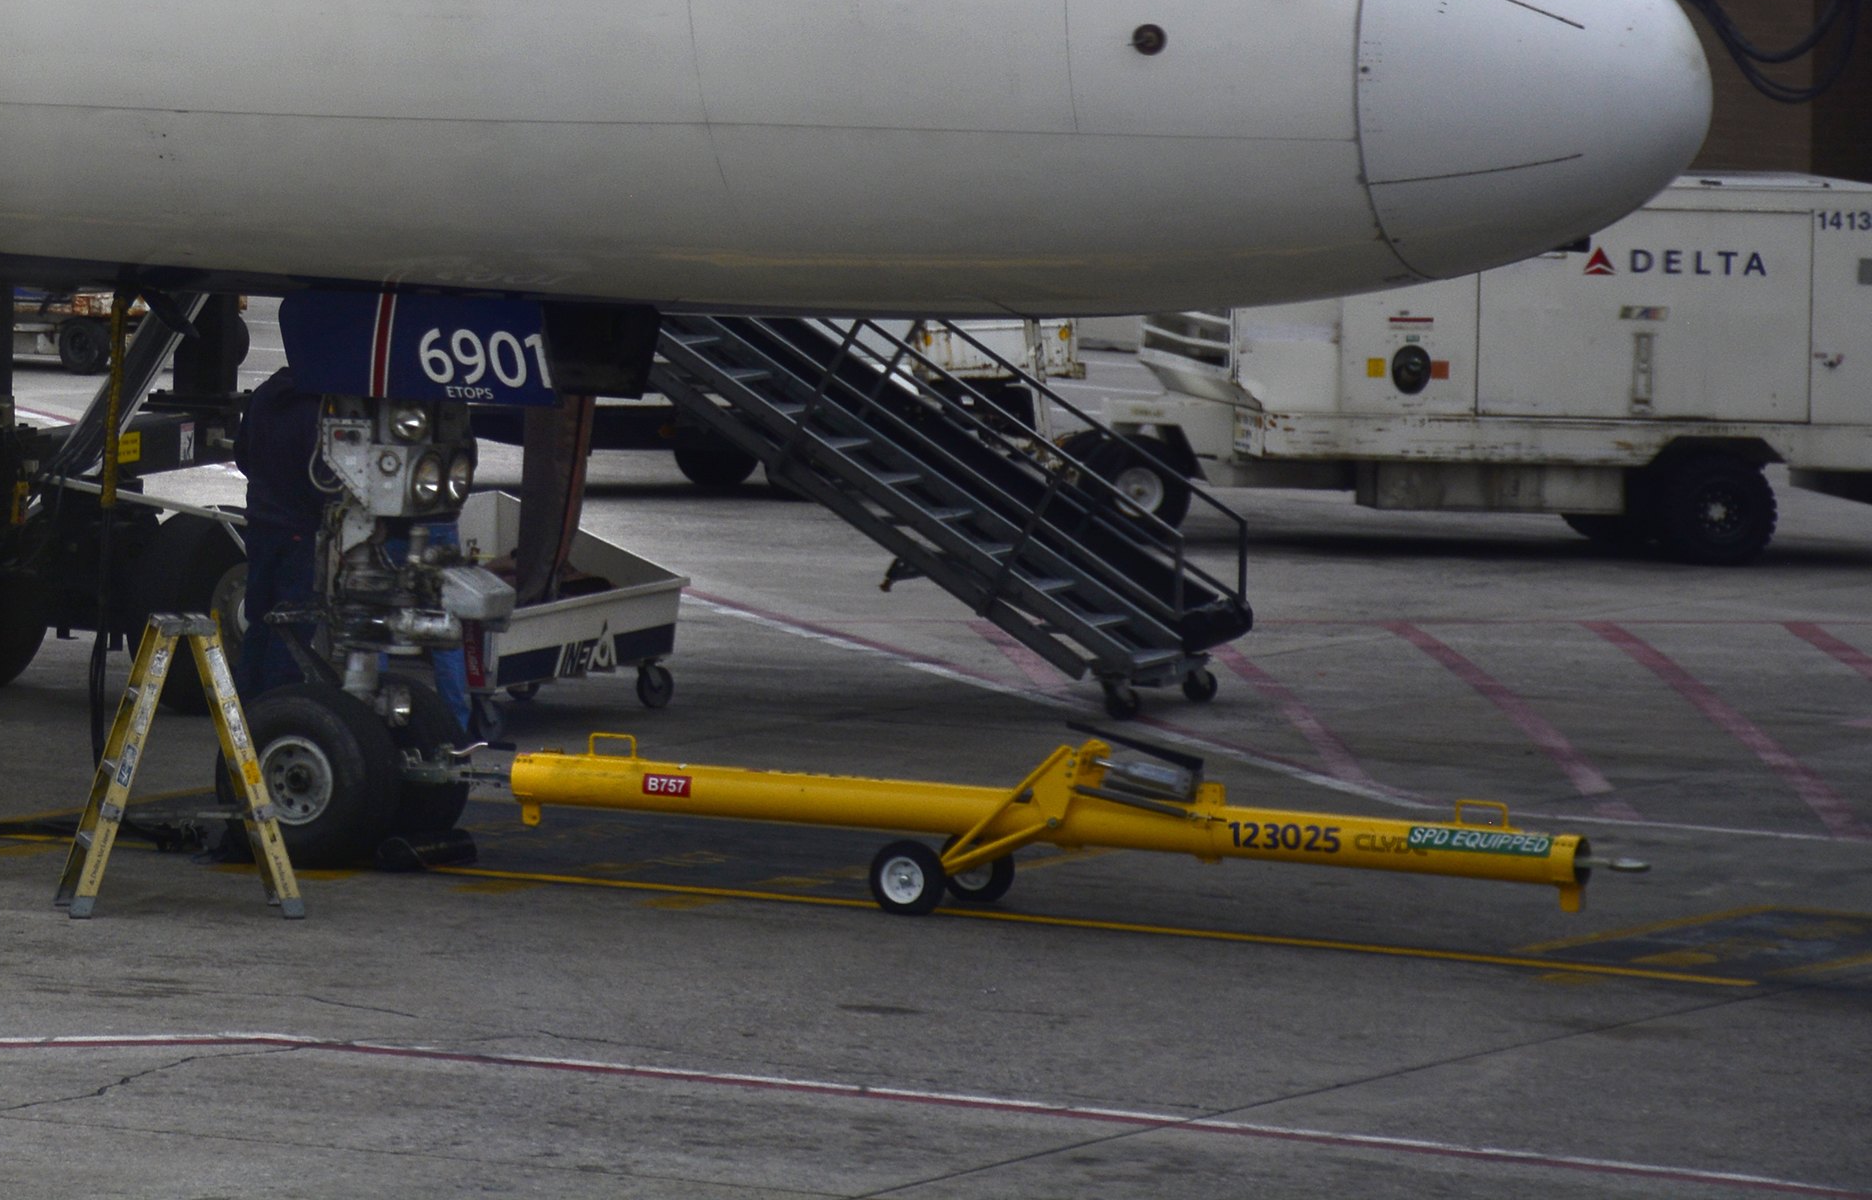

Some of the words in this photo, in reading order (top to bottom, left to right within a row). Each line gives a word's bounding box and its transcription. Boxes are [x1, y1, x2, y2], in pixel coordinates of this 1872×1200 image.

[1630, 249, 1767, 276] DELTA
[419, 328, 553, 388] 6901
[445, 386, 494, 400] ETOPS
[648, 777, 686, 793] B757
[1229, 821, 1341, 852] 123025
[1411, 828, 1450, 845] SPD
[1452, 832, 1549, 853] EQUIPPED
